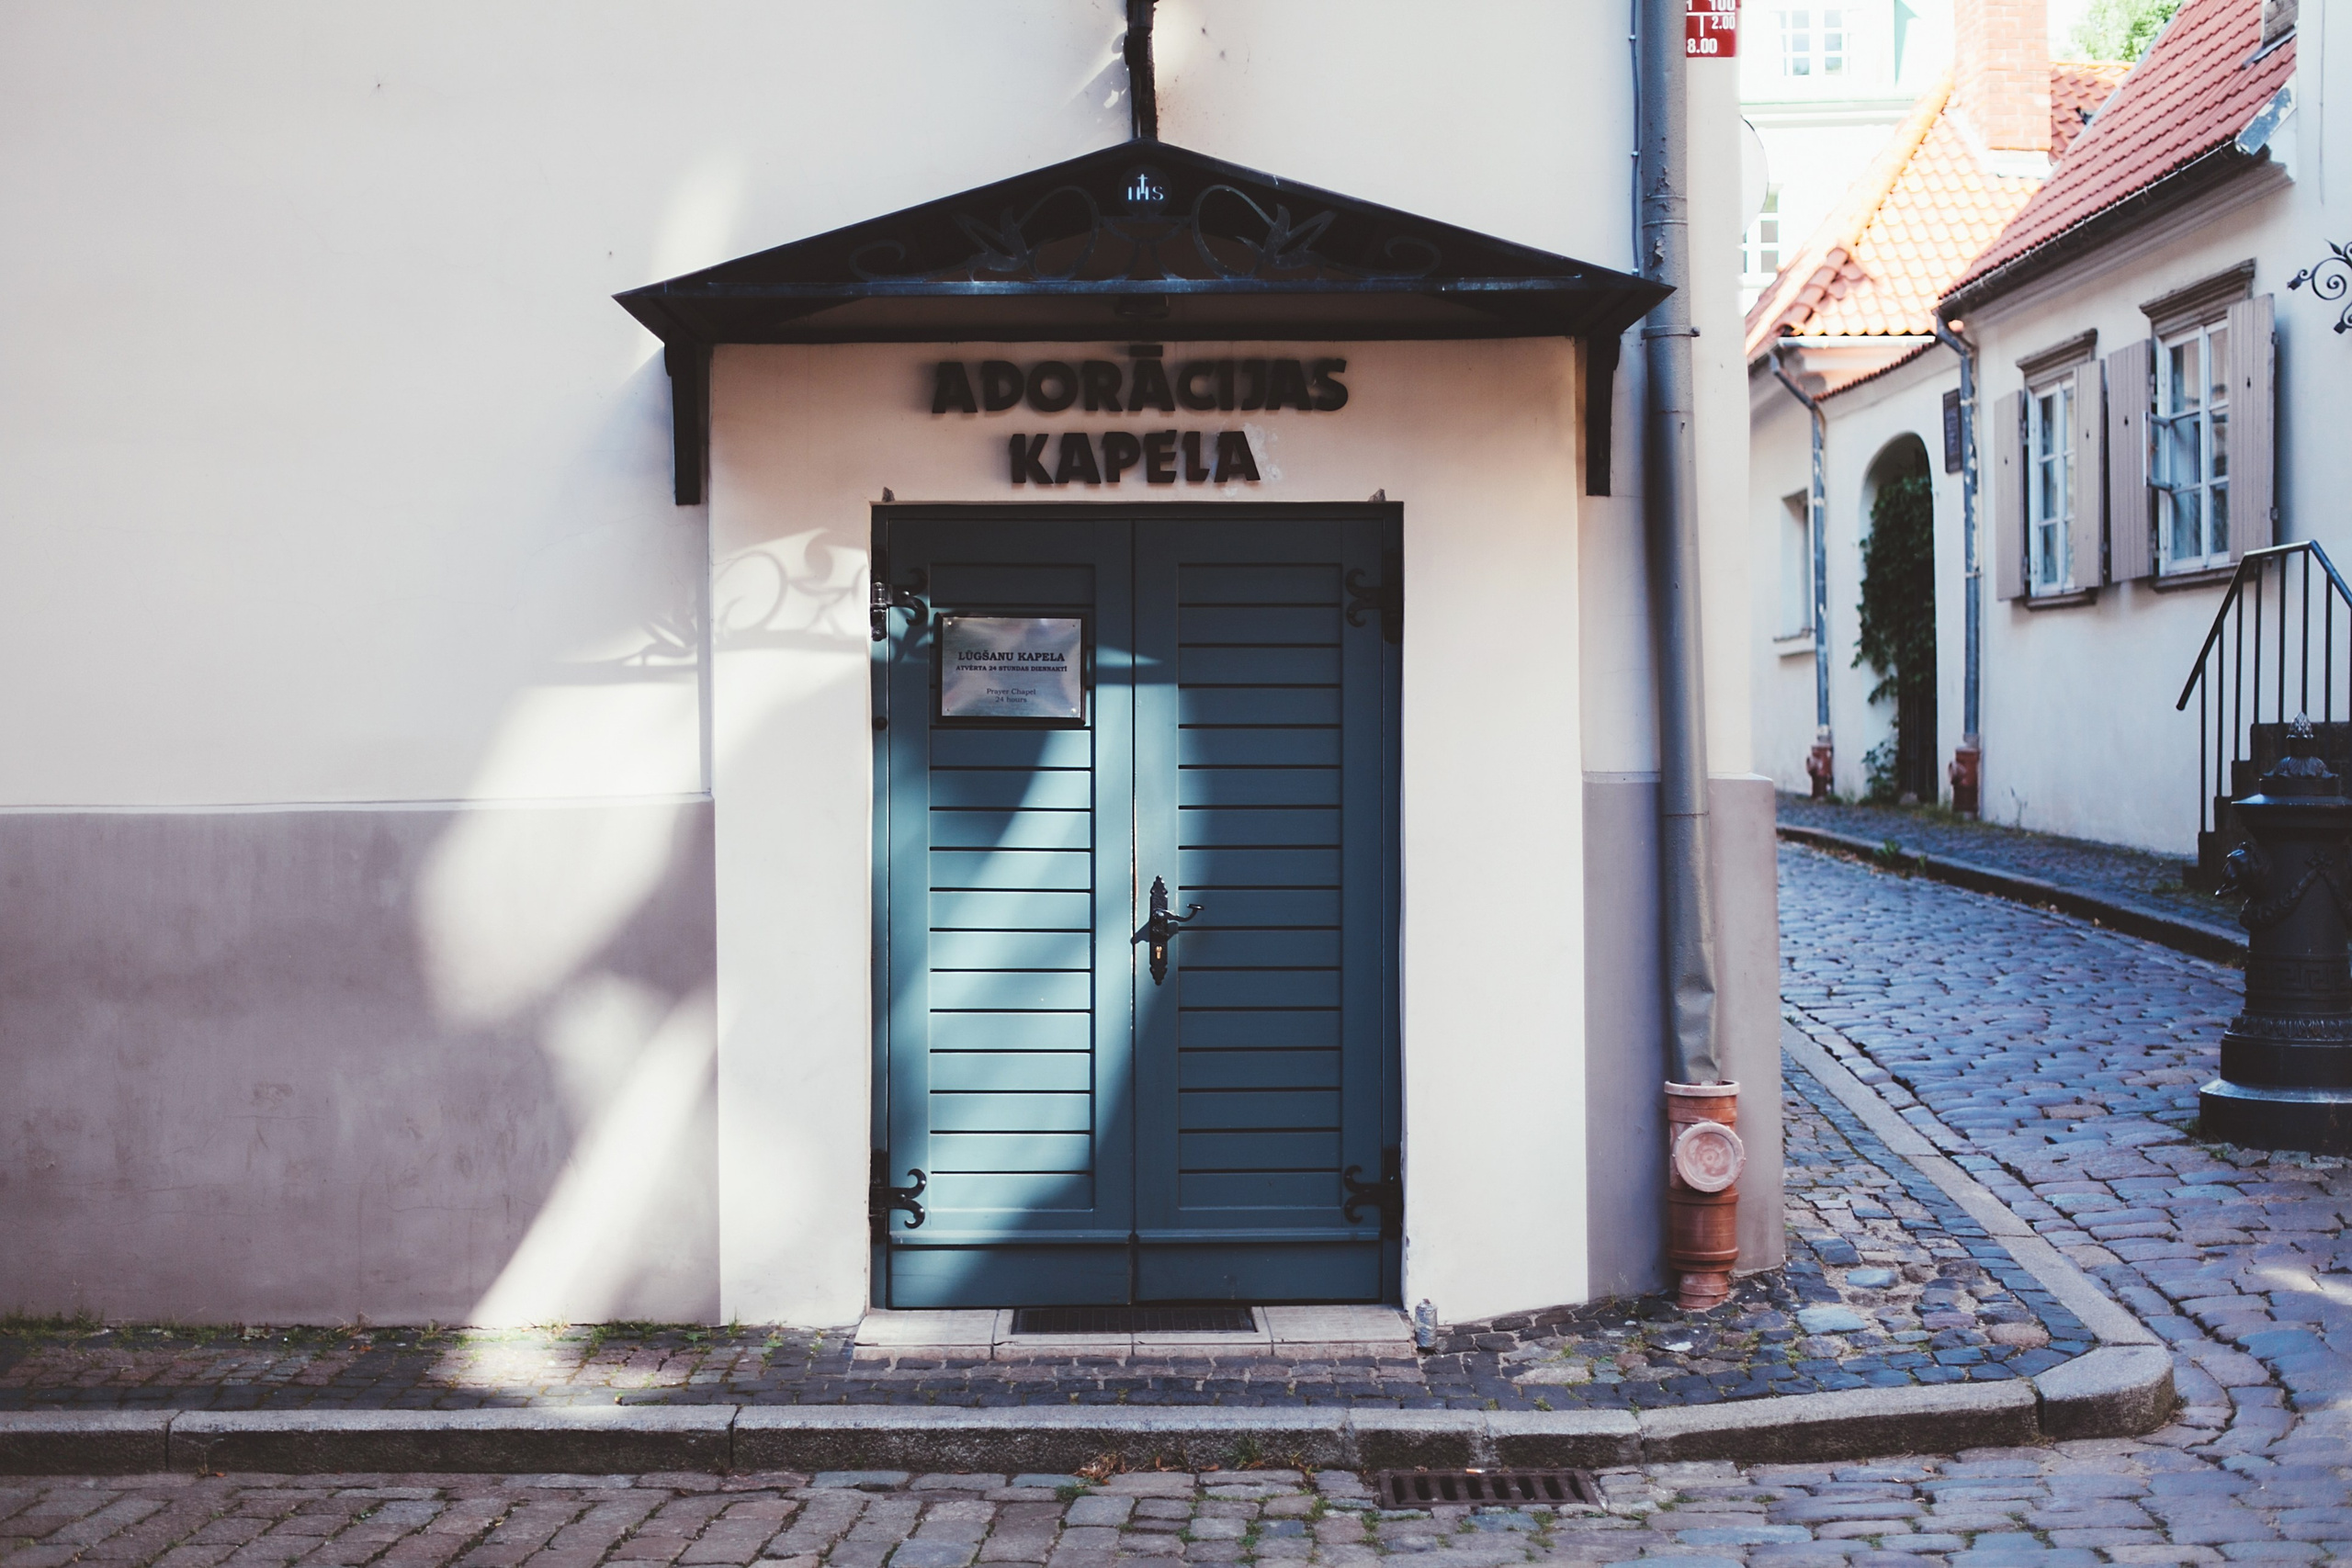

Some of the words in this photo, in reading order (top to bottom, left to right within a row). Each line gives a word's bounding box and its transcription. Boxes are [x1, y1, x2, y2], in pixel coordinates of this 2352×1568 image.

[1712, 16, 1736, 29] 2.00
[1687, 38, 1717, 53] 8.00
[932, 344, 1349, 413] ADORĀCIJAS
[1009, 430, 1261, 484] KAPELA
[958, 650, 1013, 661] LŪGŠANU
[1018, 651, 1065, 661] KAPELA
[987, 688, 1009, 696] Prayer
[1011, 688, 1036, 696] Chapel
